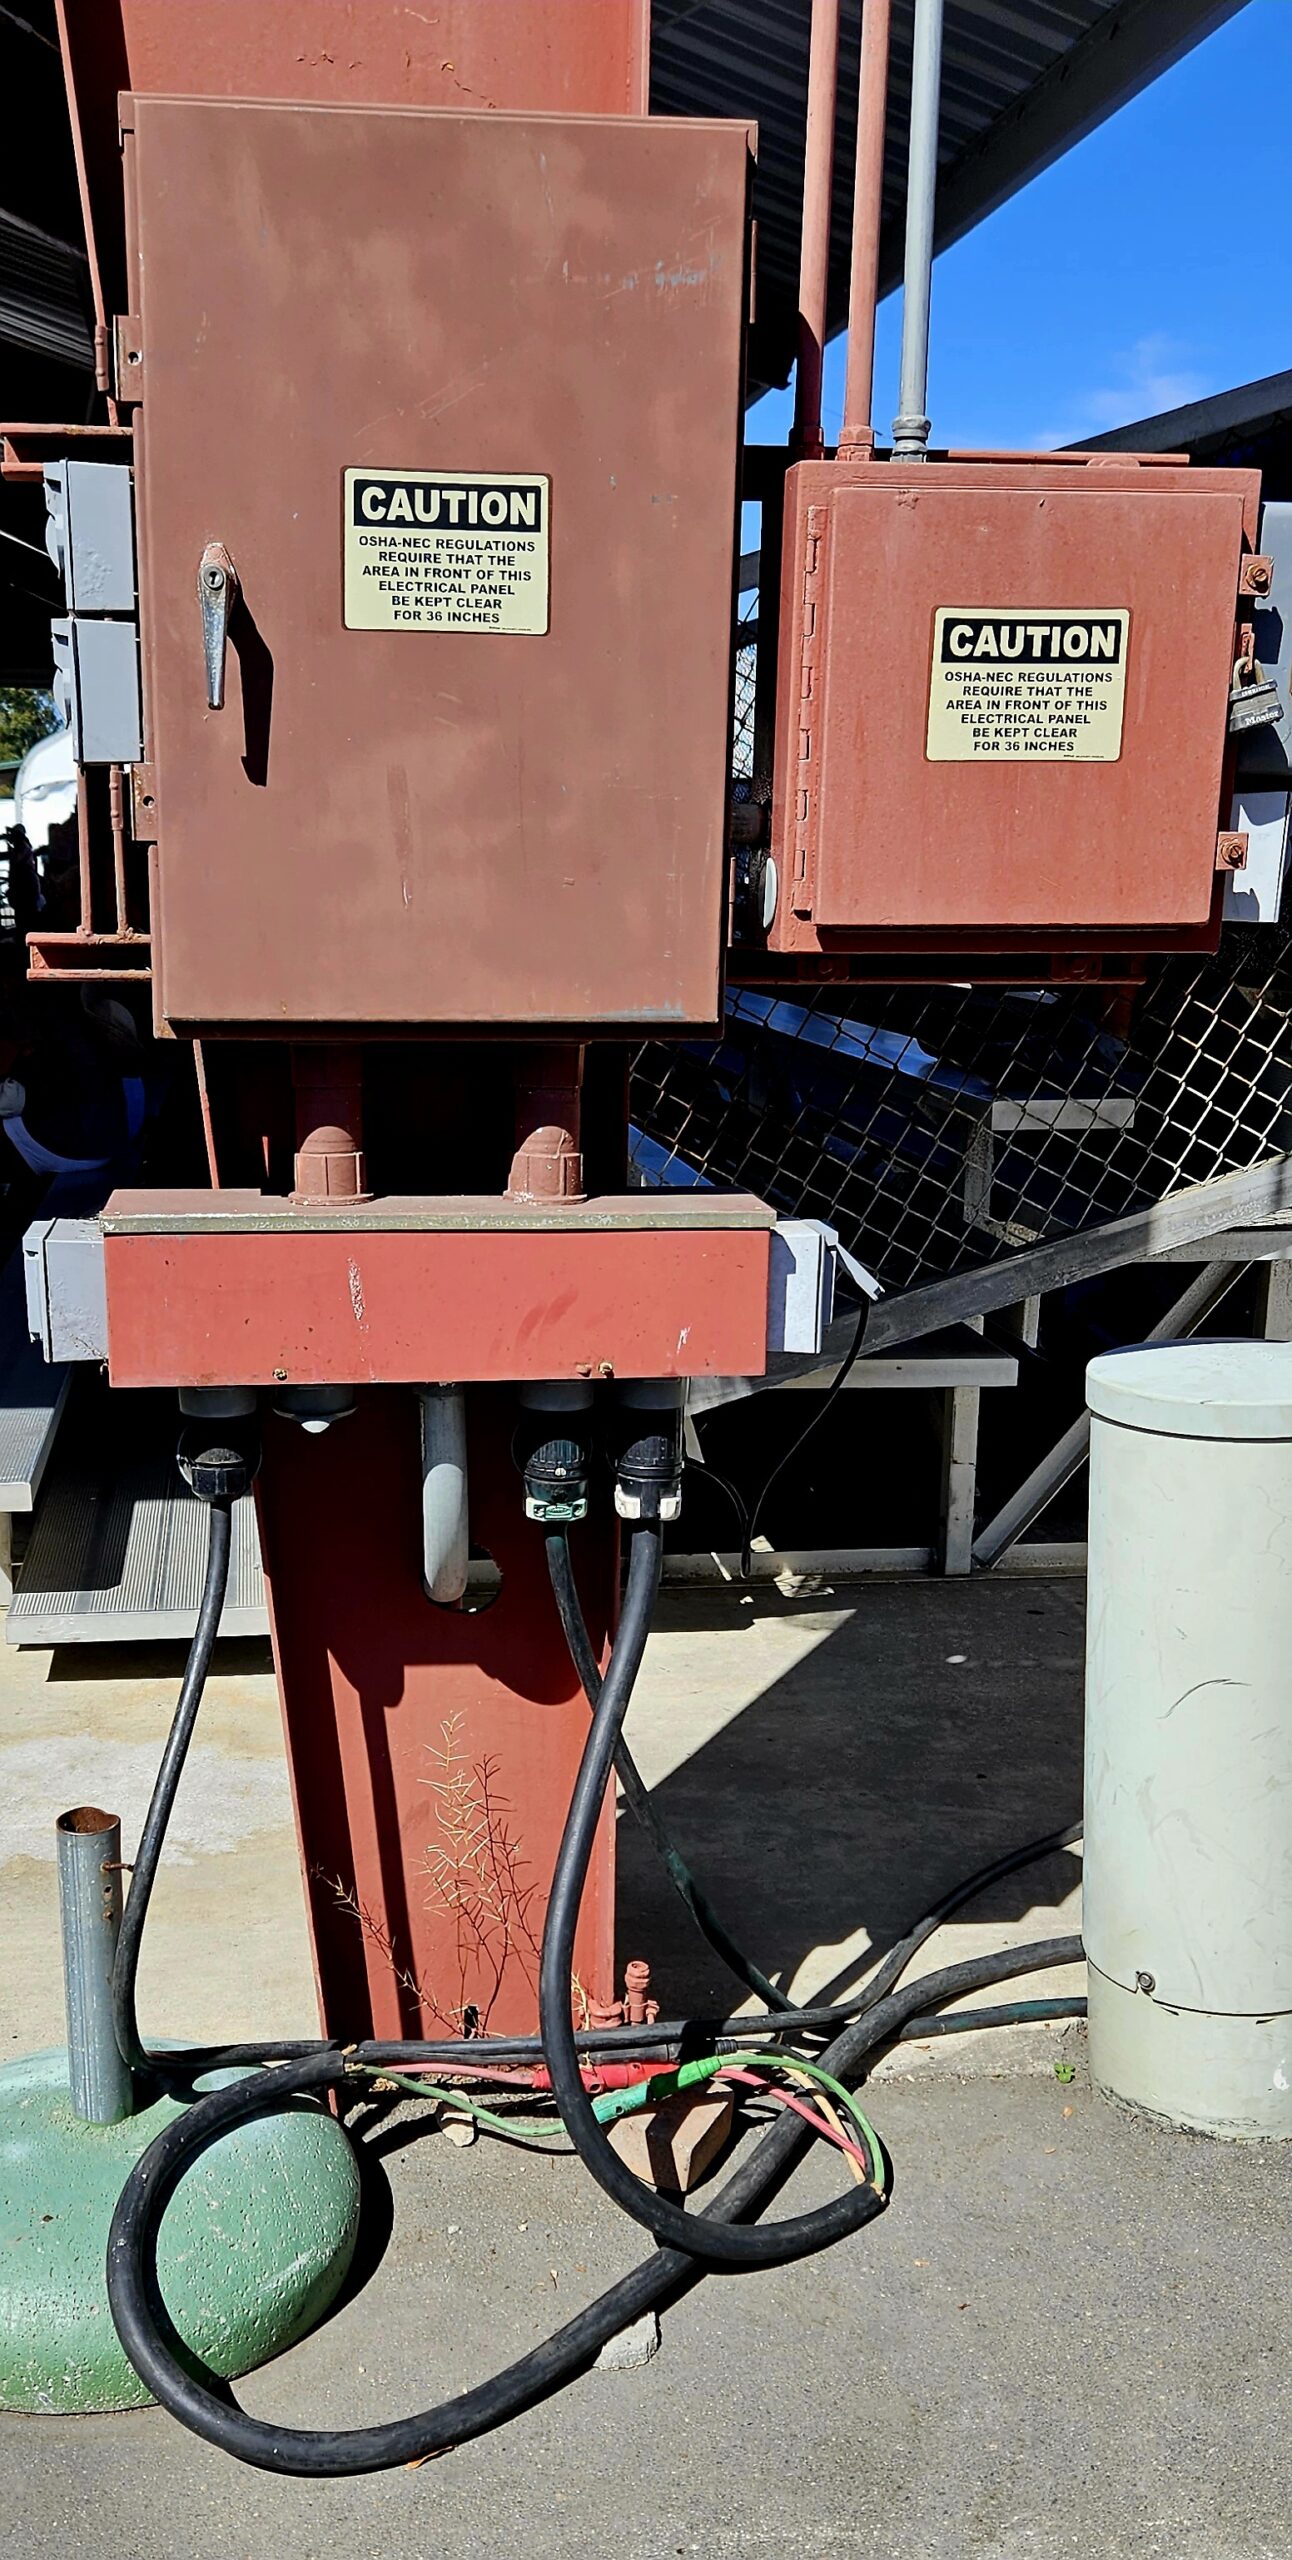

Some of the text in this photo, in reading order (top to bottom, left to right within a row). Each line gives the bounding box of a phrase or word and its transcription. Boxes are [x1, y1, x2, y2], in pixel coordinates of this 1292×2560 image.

[361, 486, 536, 526] CAUTION
[359, 535, 535, 553] OSHA-NEC REGULATIONS
[378, 551, 516, 567] REQUIRE THAT THE
[362, 565, 532, 582] AREA IN FRONT OF THIS
[378, 580, 515, 596] ELECTRICAL PANEL
[391, 595, 503, 610] BE KEPT CLEAR
[393, 609, 500, 624] FOR 36 INCHES
[949, 624, 1116, 659] CAUTION
[944, 671, 1113, 683] OSHA-NEC REGULATIONS
[962, 685, 1093, 697] REQUIRE THAT THE
[945, 699, 1108, 711] AREA IN FRONT OF THIS
[961, 713, 1091, 725] ELECTRICAL PANEL
[1244, 710, 1279, 726] Master
[972, 727, 1078, 738] BE KEPT CLEAR
[973, 741, 1075, 752] FOR 36 INCHES
